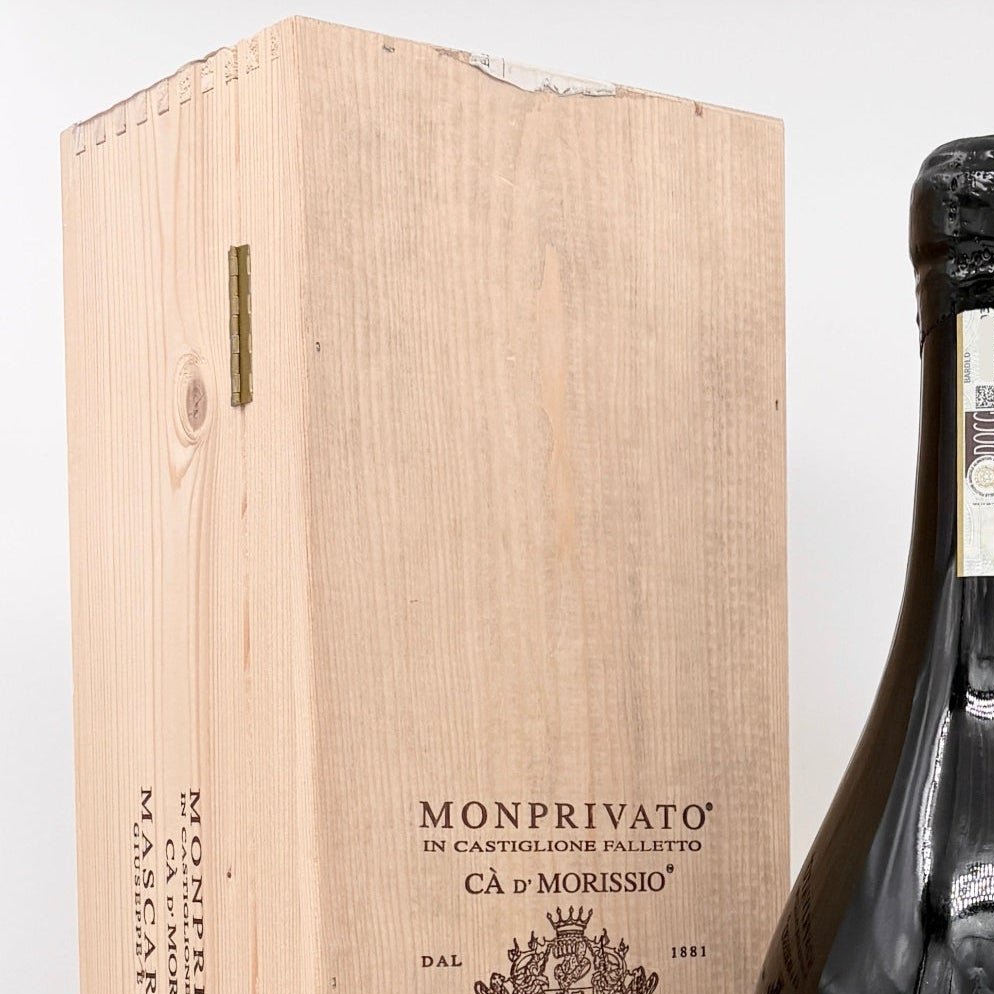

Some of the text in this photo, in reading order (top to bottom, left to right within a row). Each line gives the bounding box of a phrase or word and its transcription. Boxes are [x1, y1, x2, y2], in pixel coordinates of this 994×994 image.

[180, 791, 187, 817] IN
[418, 800, 706, 831] MONPRIVATO
[423, 839, 703, 853] IN CASTIGLIONE FALLETTO
[165, 838, 178, 884] CÀ
[133, 822, 143, 959] GIUSEPPE
[464, 867, 505, 895] CÀ
[537, 871, 666, 894] MORISSIO
[422, 946, 707, 969] DAL 1881
